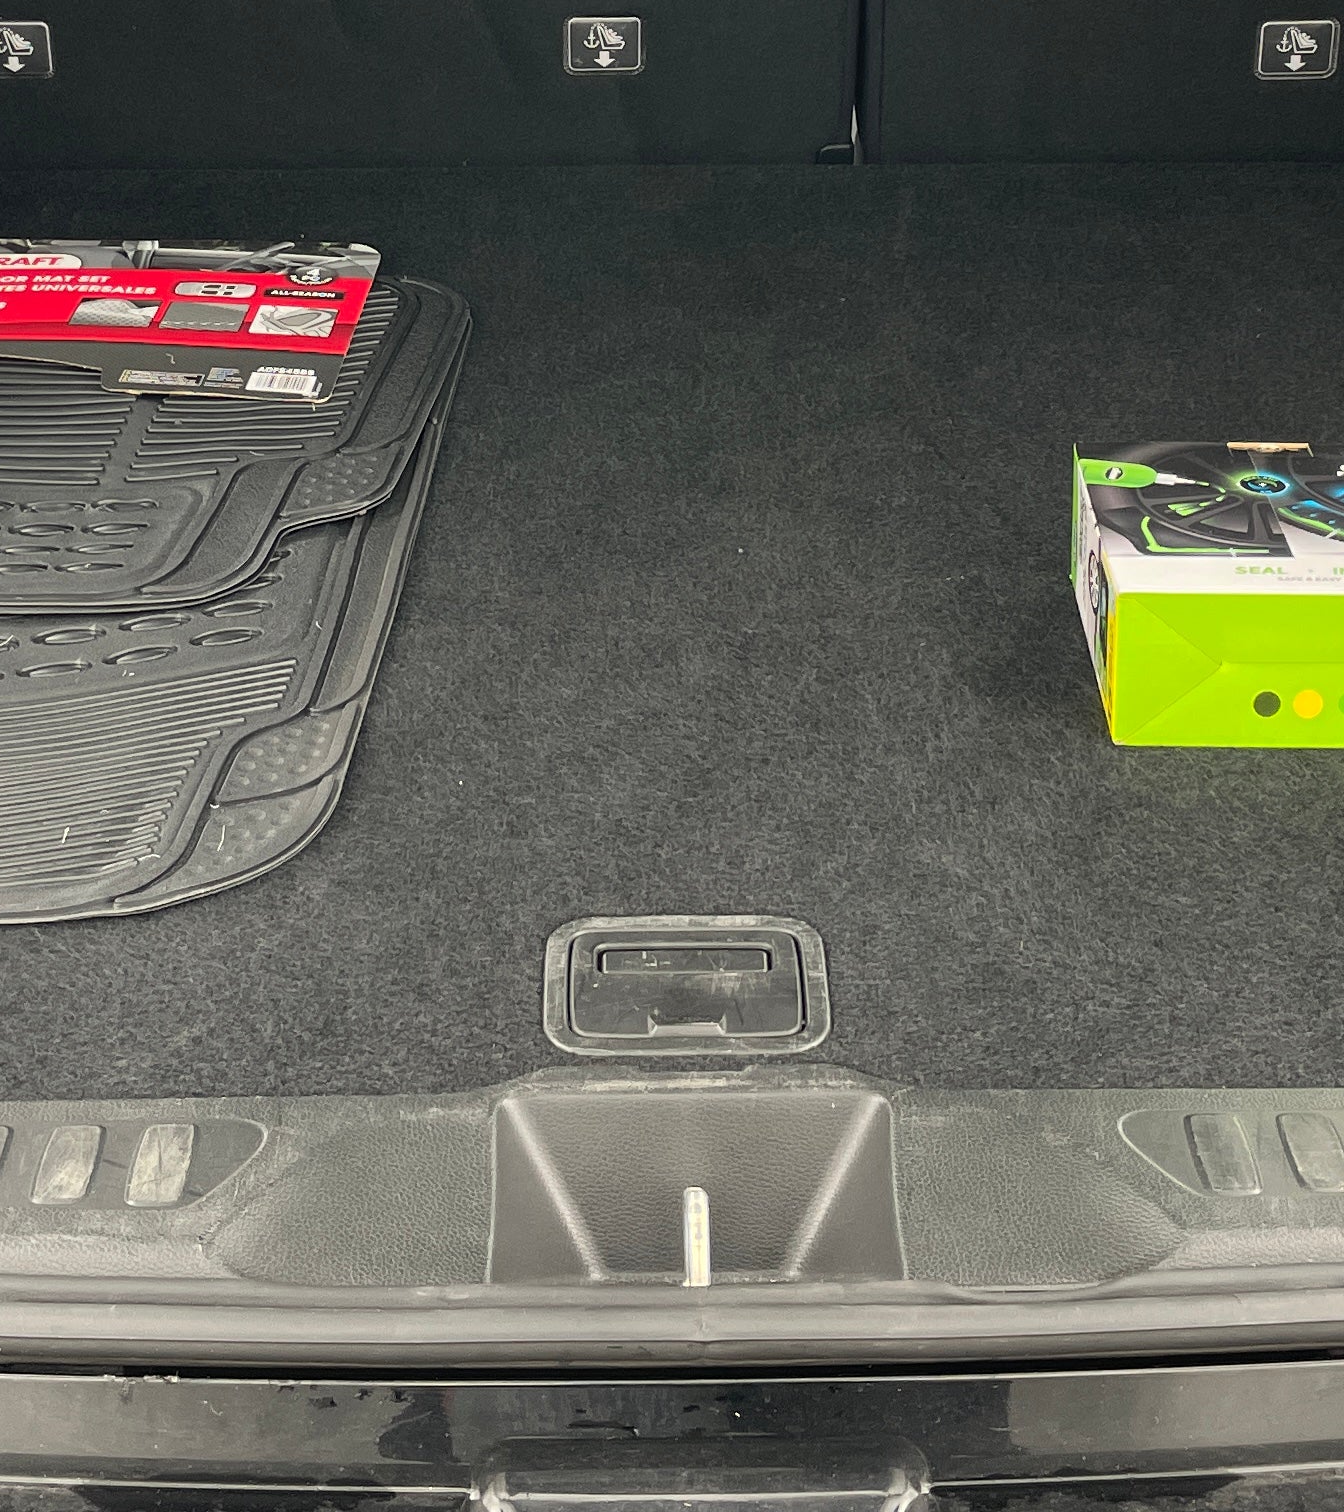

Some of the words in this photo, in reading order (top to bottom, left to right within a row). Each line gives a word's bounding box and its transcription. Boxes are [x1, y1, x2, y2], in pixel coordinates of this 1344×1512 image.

[32, 275, 73, 283] MAT
[77, 275, 112, 283] SET
[31, 284, 157, 295] UNIVERSALES
[1234, 566, 1288, 576] SEAL
